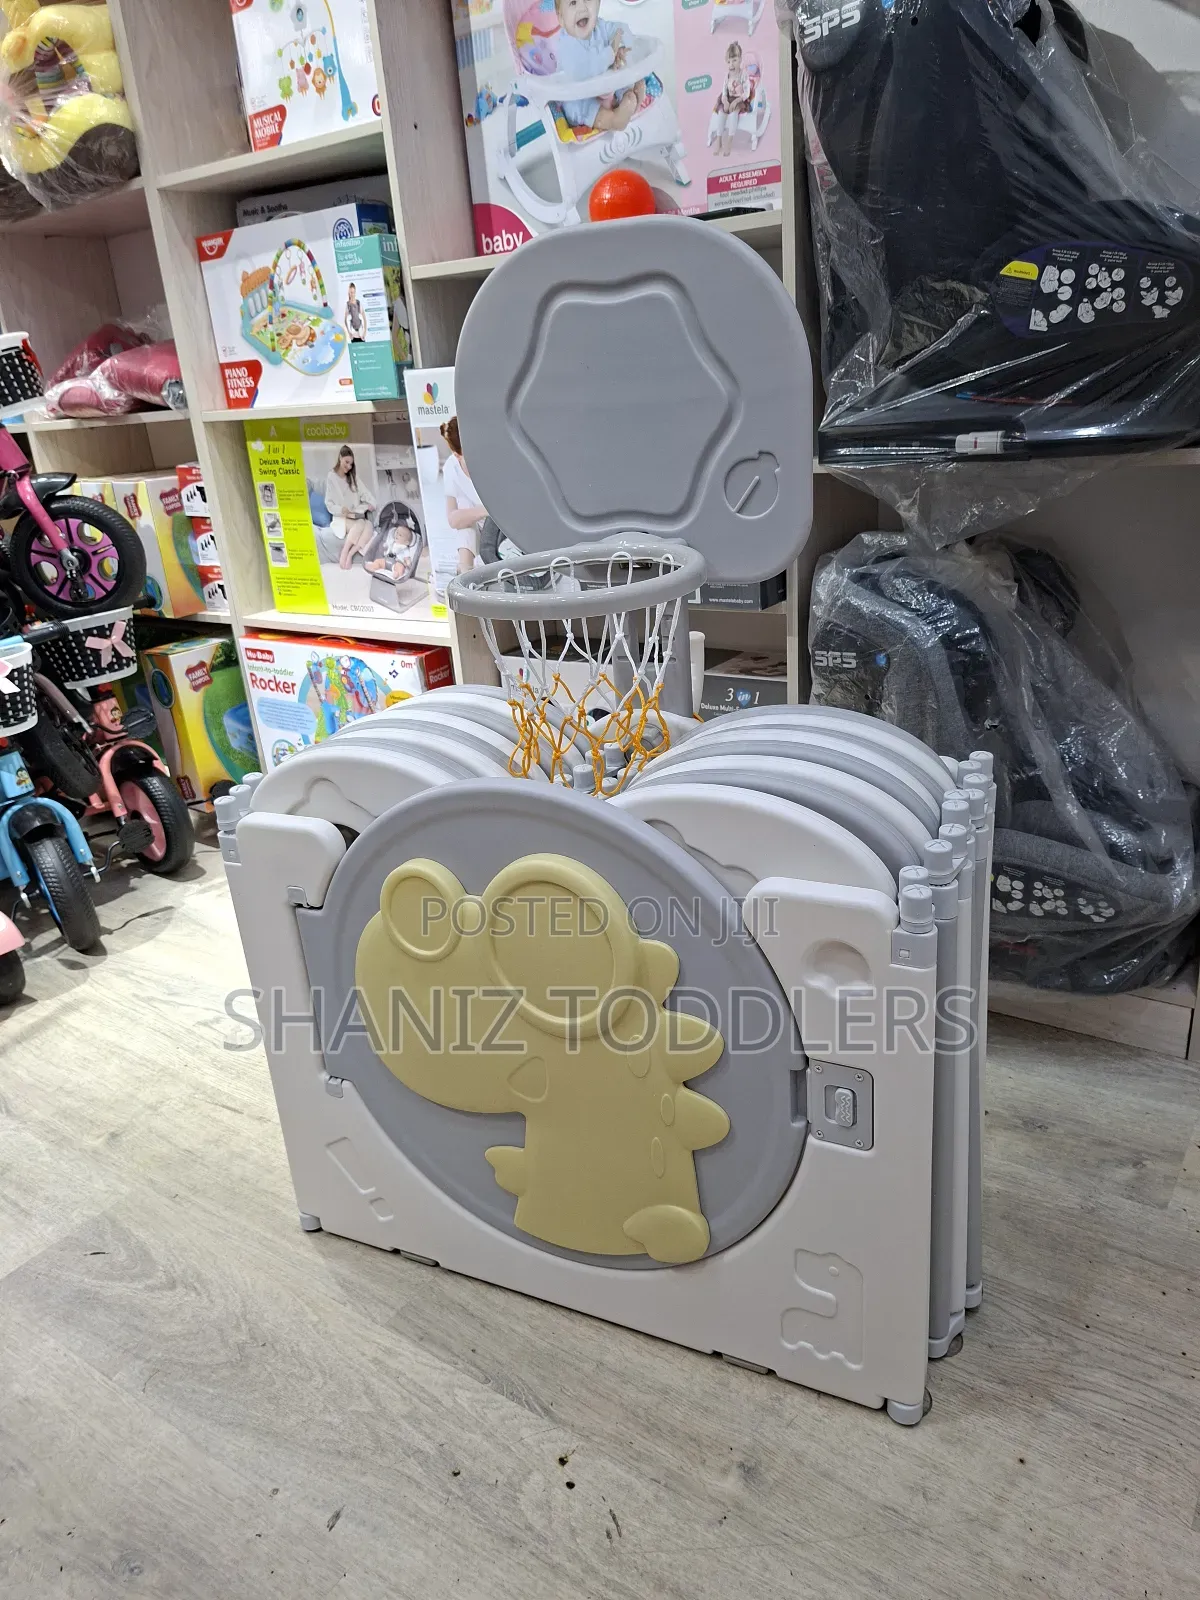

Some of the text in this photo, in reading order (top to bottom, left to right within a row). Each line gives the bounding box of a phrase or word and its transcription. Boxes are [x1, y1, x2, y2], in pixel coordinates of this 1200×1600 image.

[803, 0, 861, 44] SPS
[253, 111, 282, 127] MUSICAL
[255, 123, 280, 139] MOBILE
[719, 169, 768, 184] ADULT ASSEMBLY
[730, 179, 758, 189] REQUIRED
[243, 208, 258, 217] Music
[482, 229, 523, 254] baby
[224, 367, 248, 379] PIANO
[226, 376, 255, 388] FITNESS
[229, 388, 249, 399] RACK
[417, 405, 449, 416] mastela
[306, 424, 346, 437] coolbaby
[259, 457, 297, 468] Deluxe Baby
[258, 467, 300, 477] Swing Classic
[162, 493, 179, 504] FAMILY
[814, 650, 857, 669] SPS
[188, 666, 208, 681] FAMILY
[429, 669, 450, 685] Rocker
[249, 672, 297, 695] Rocker
[725, 687, 760, 705] 3 in 1
[700, 702, 719, 711] Deluxe
